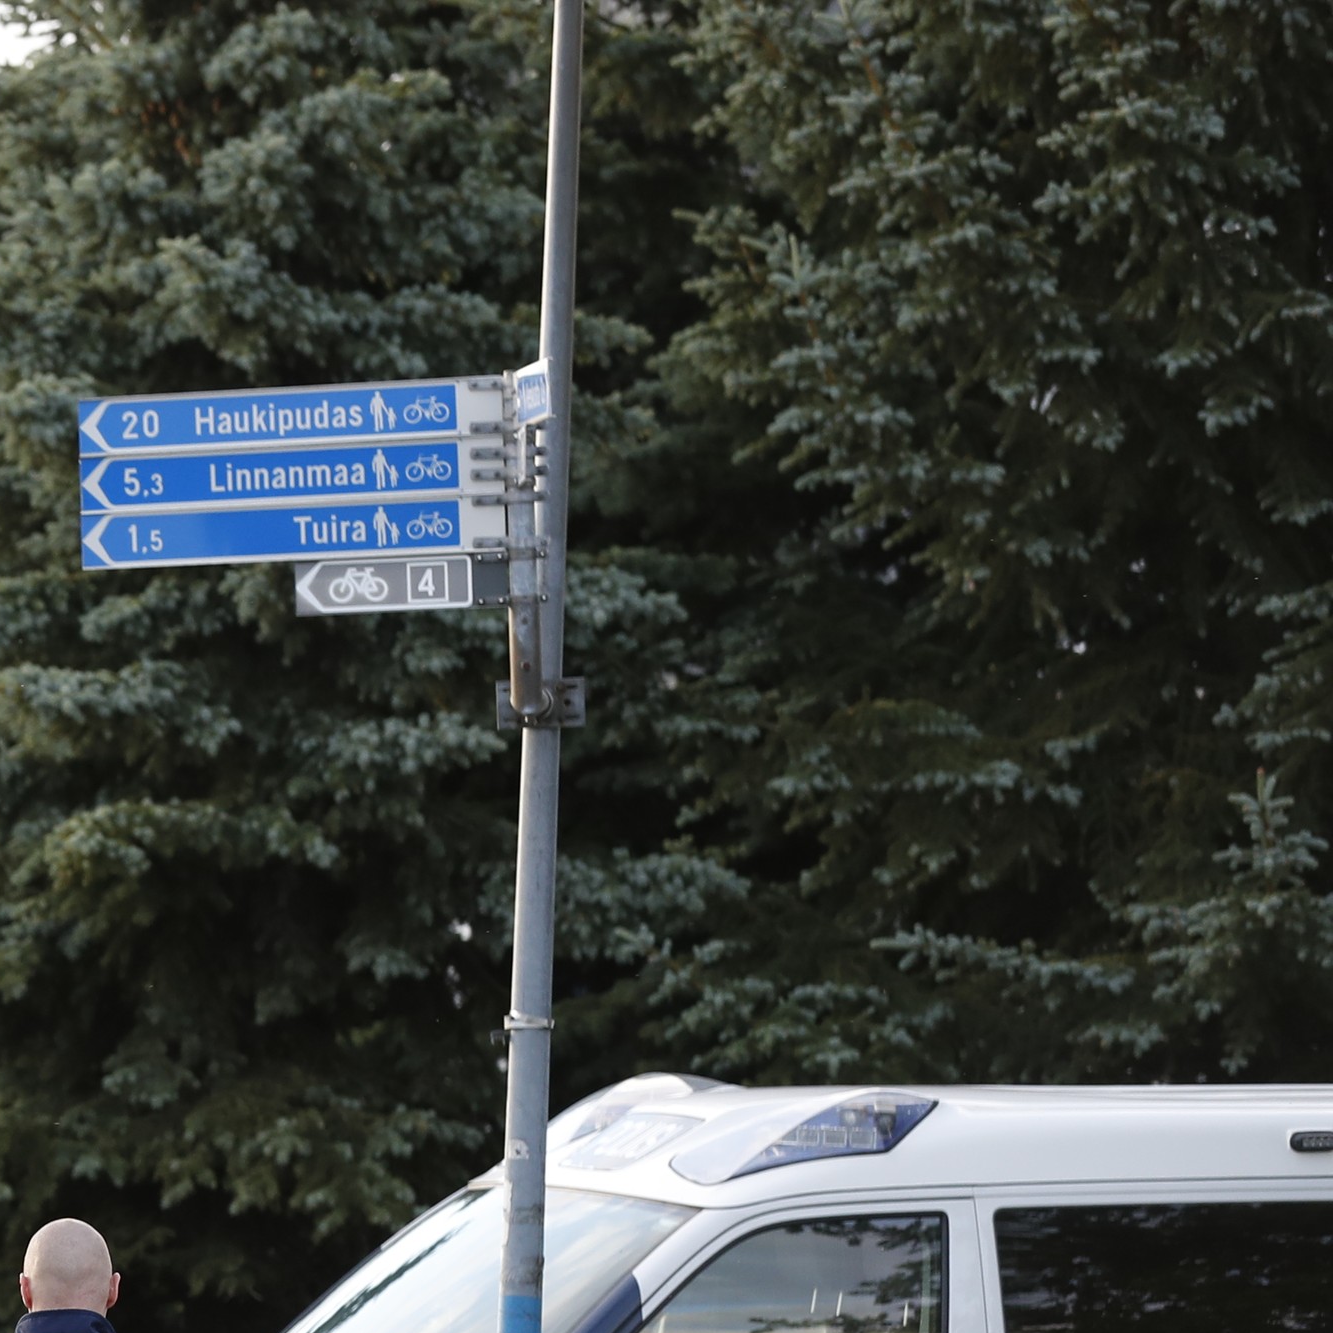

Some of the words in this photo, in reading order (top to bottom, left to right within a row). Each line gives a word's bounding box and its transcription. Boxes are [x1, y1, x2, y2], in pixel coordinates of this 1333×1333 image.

[121, 410, 160, 440] 20
[194, 400, 364, 437] Haukipudas
[123, 467, 165, 498] 5,3
[209, 461, 367, 493] Linnanmaa
[128, 524, 164, 556] 1,5
[293, 514, 367, 546] Tuira
[417, 568, 435, 597] 4
